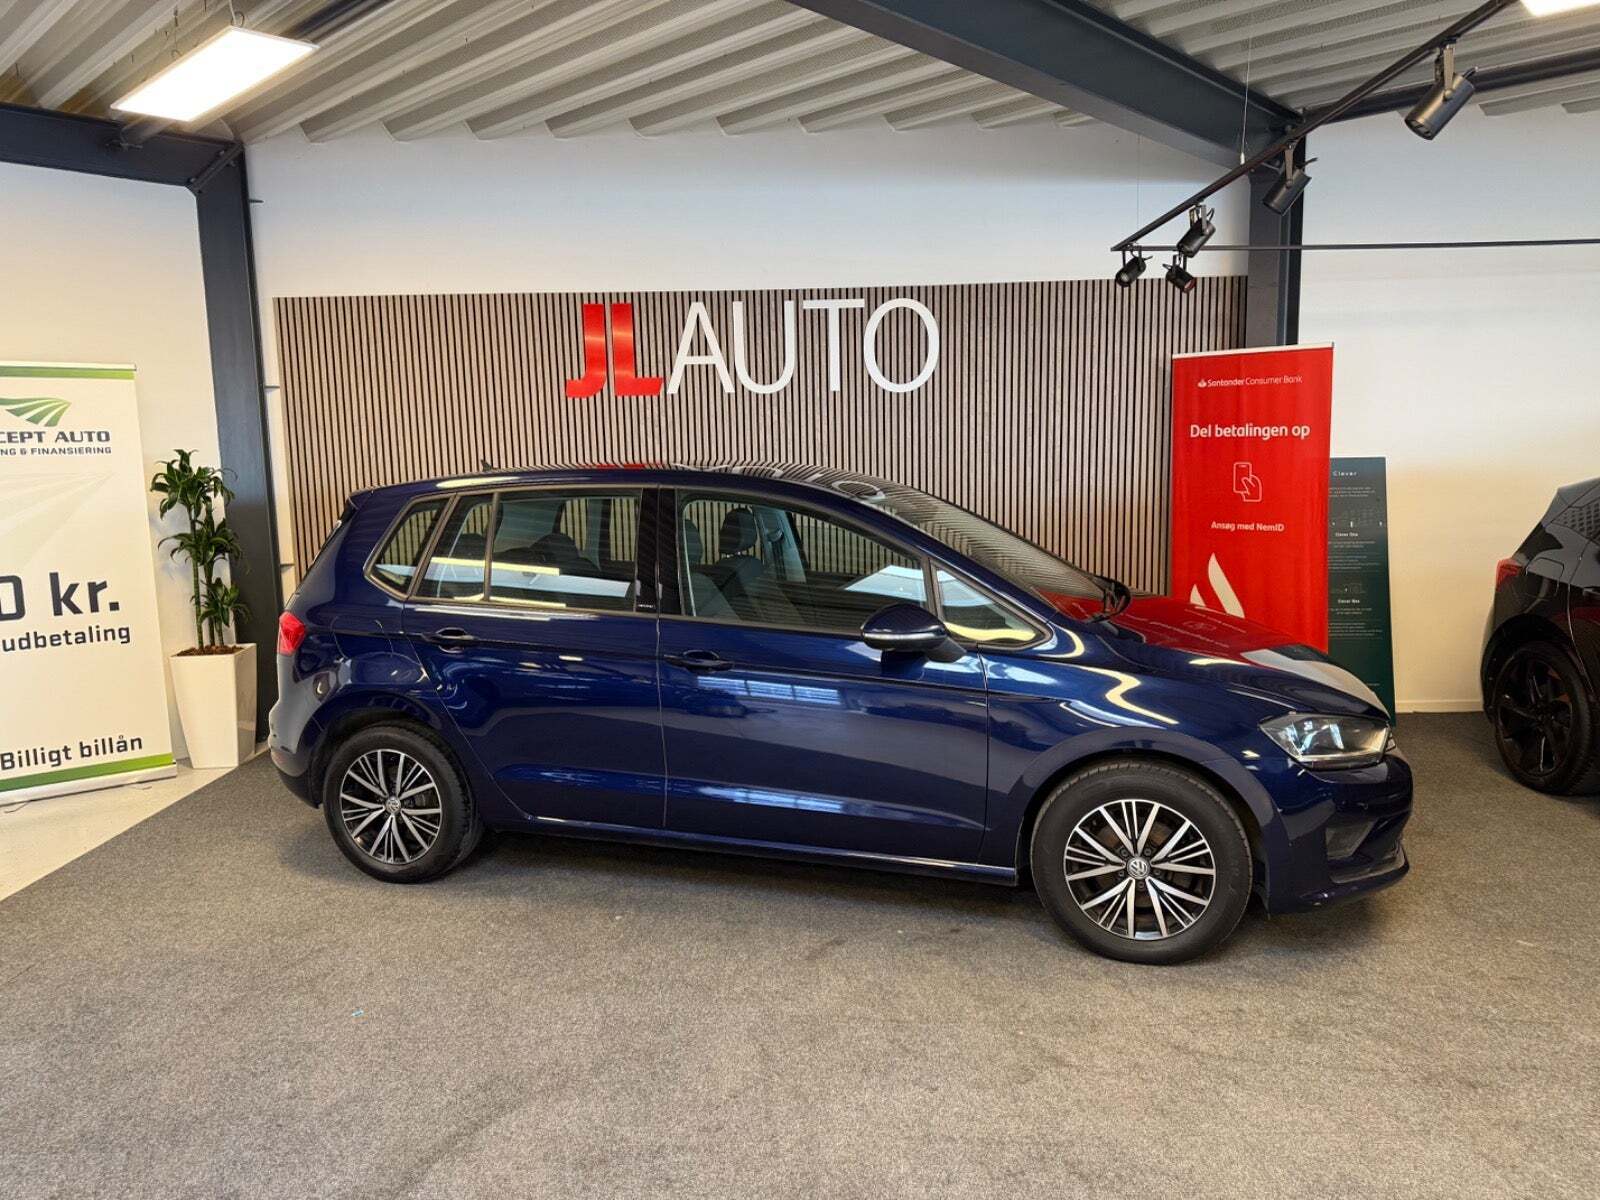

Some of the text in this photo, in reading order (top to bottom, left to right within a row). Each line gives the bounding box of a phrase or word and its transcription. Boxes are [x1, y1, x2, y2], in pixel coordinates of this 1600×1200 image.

[565, 297, 940, 399] JL AUTO
[1207, 374, 1303, 388] Santander Consumer Bank
[55, 430, 111, 443] AUTO
[1190, 423, 1311, 440] Del betalingen op
[30, 446, 112, 455] FINANSIERING
[1237, 522, 1255, 531] med
[1256, 523, 1285, 532] NemID
[49, 571, 120, 617] kr.
[1, 624, 131, 653] udbetaling
[0, 734, 143, 771] Billigt billån
